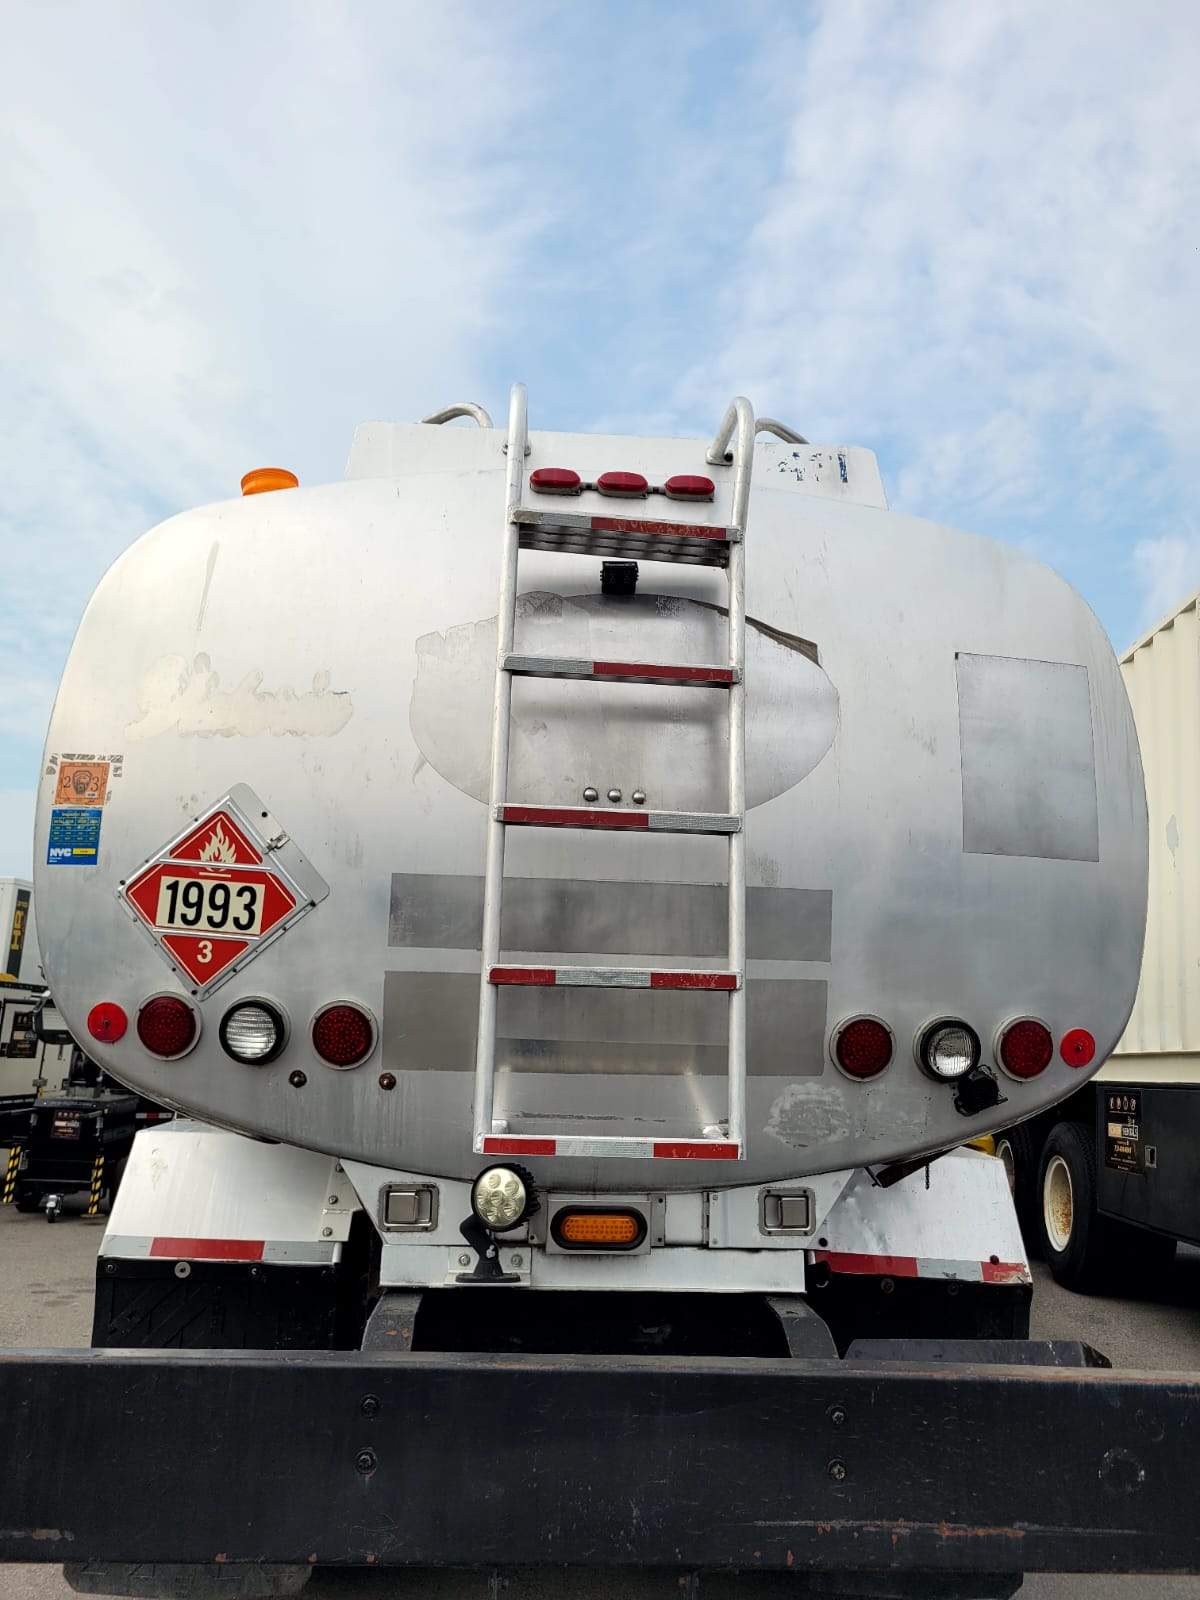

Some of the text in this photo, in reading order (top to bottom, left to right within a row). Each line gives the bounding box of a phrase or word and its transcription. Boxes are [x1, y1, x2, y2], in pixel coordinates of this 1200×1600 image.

[49, 847, 72, 857] NYC
[166, 880, 257, 931] 1993
[196, 940, 213, 964] 3
